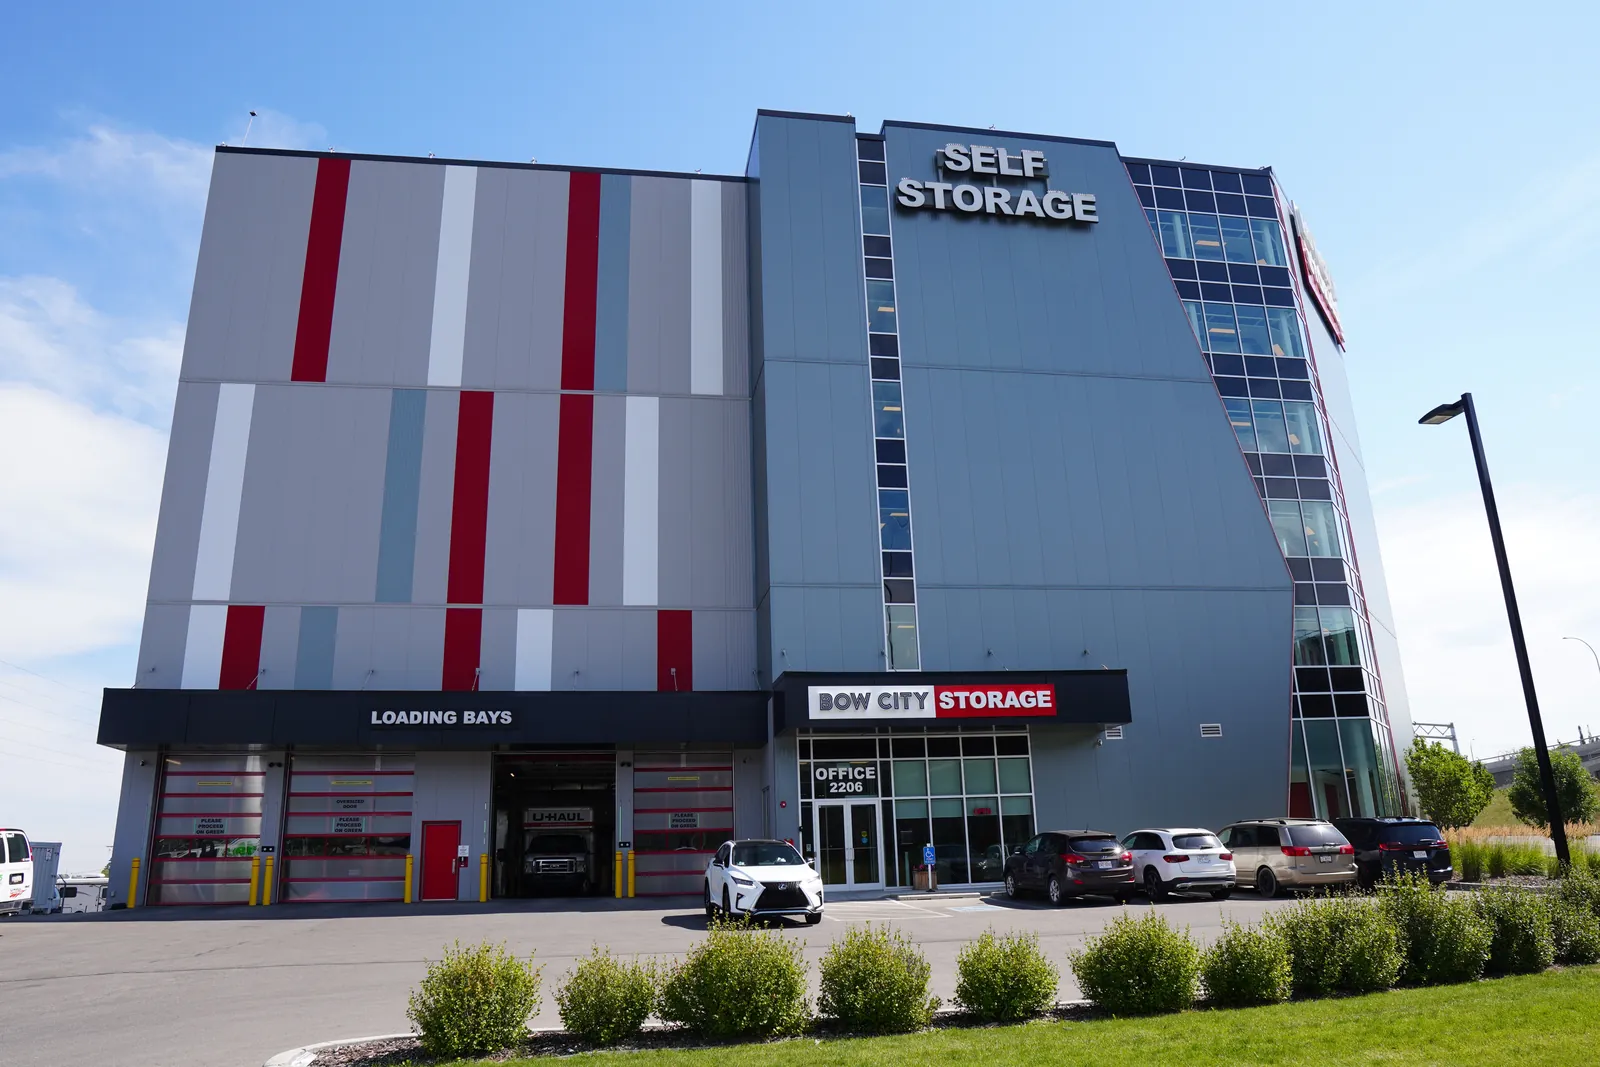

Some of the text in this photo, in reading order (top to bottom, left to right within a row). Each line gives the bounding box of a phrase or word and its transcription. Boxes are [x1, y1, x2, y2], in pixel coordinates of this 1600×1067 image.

[943, 144, 1045, 177] SELF
[897, 179, 1099, 222] STORAGE
[819, 689, 1052, 711] BOW CITY STORAGE
[371, 711, 512, 724] LOADING BAYS
[815, 767, 876, 780] OFFICE
[829, 782, 863, 793] 2206
[533, 812, 585, 821] U-HAUL
